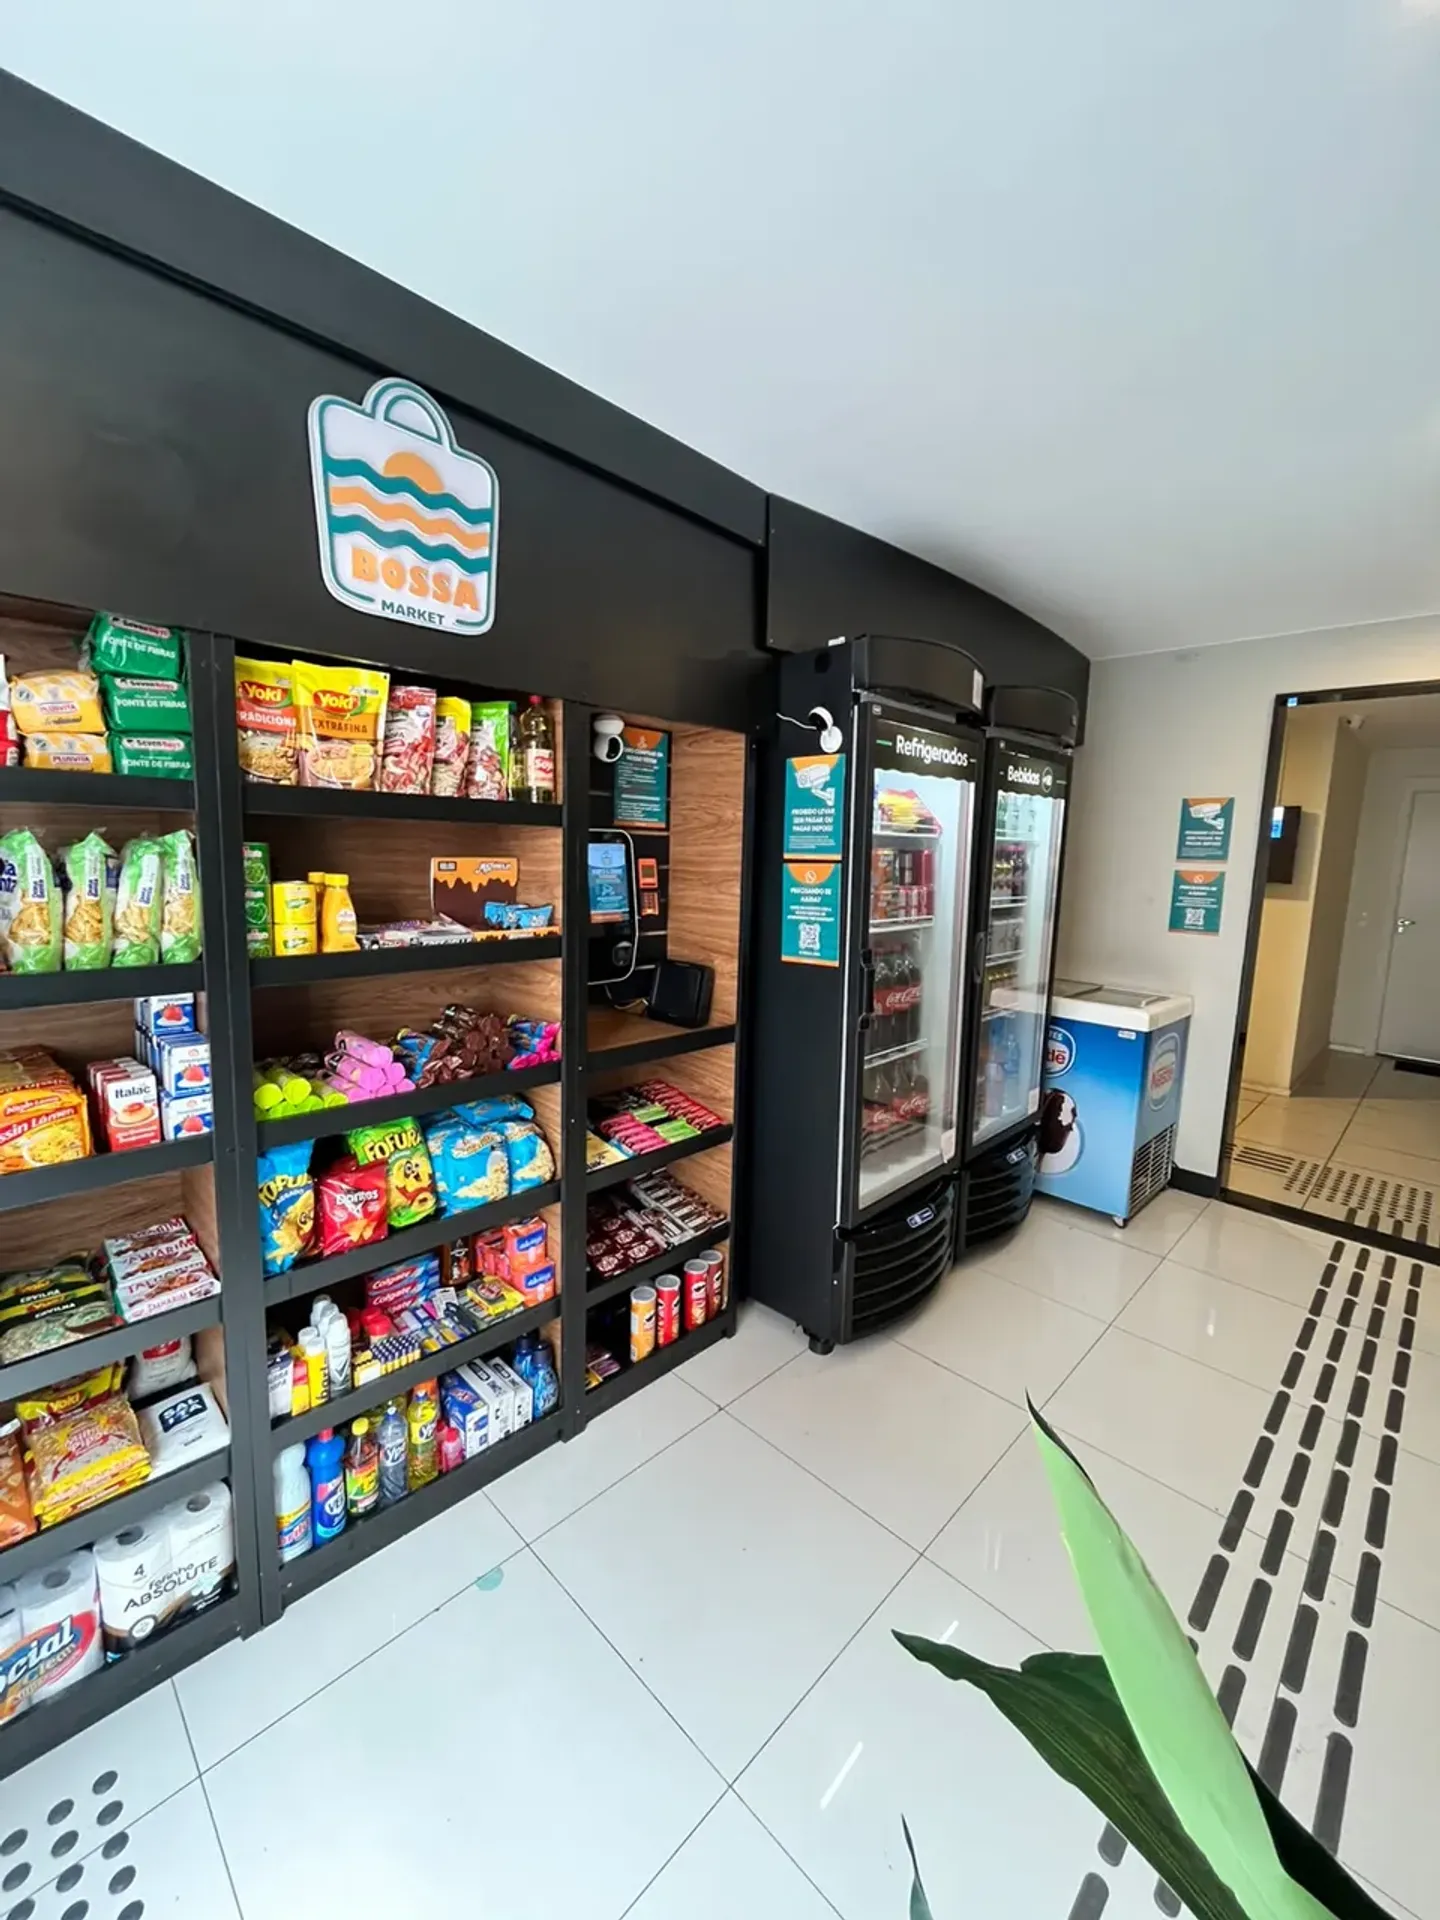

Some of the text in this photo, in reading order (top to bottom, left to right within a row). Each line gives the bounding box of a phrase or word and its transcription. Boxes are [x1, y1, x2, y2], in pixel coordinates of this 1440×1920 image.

[351, 546, 480, 612] BOSSA
[381, 599, 445, 626] MARKET
[245, 683, 283, 702] Yoki
[320, 692, 357, 710] Yoki
[895, 734, 968, 767] Refrigerados
[1007, 765, 1040, 786] Bebidas
[115, 1085, 151, 1099] Italac
[335, 1189, 379, 1205] Doritos
[49, 1391, 81, 1412] Yoki
[134, 1564, 145, 1577] 4
[123, 1555, 219, 1613] ABSOLUTE
